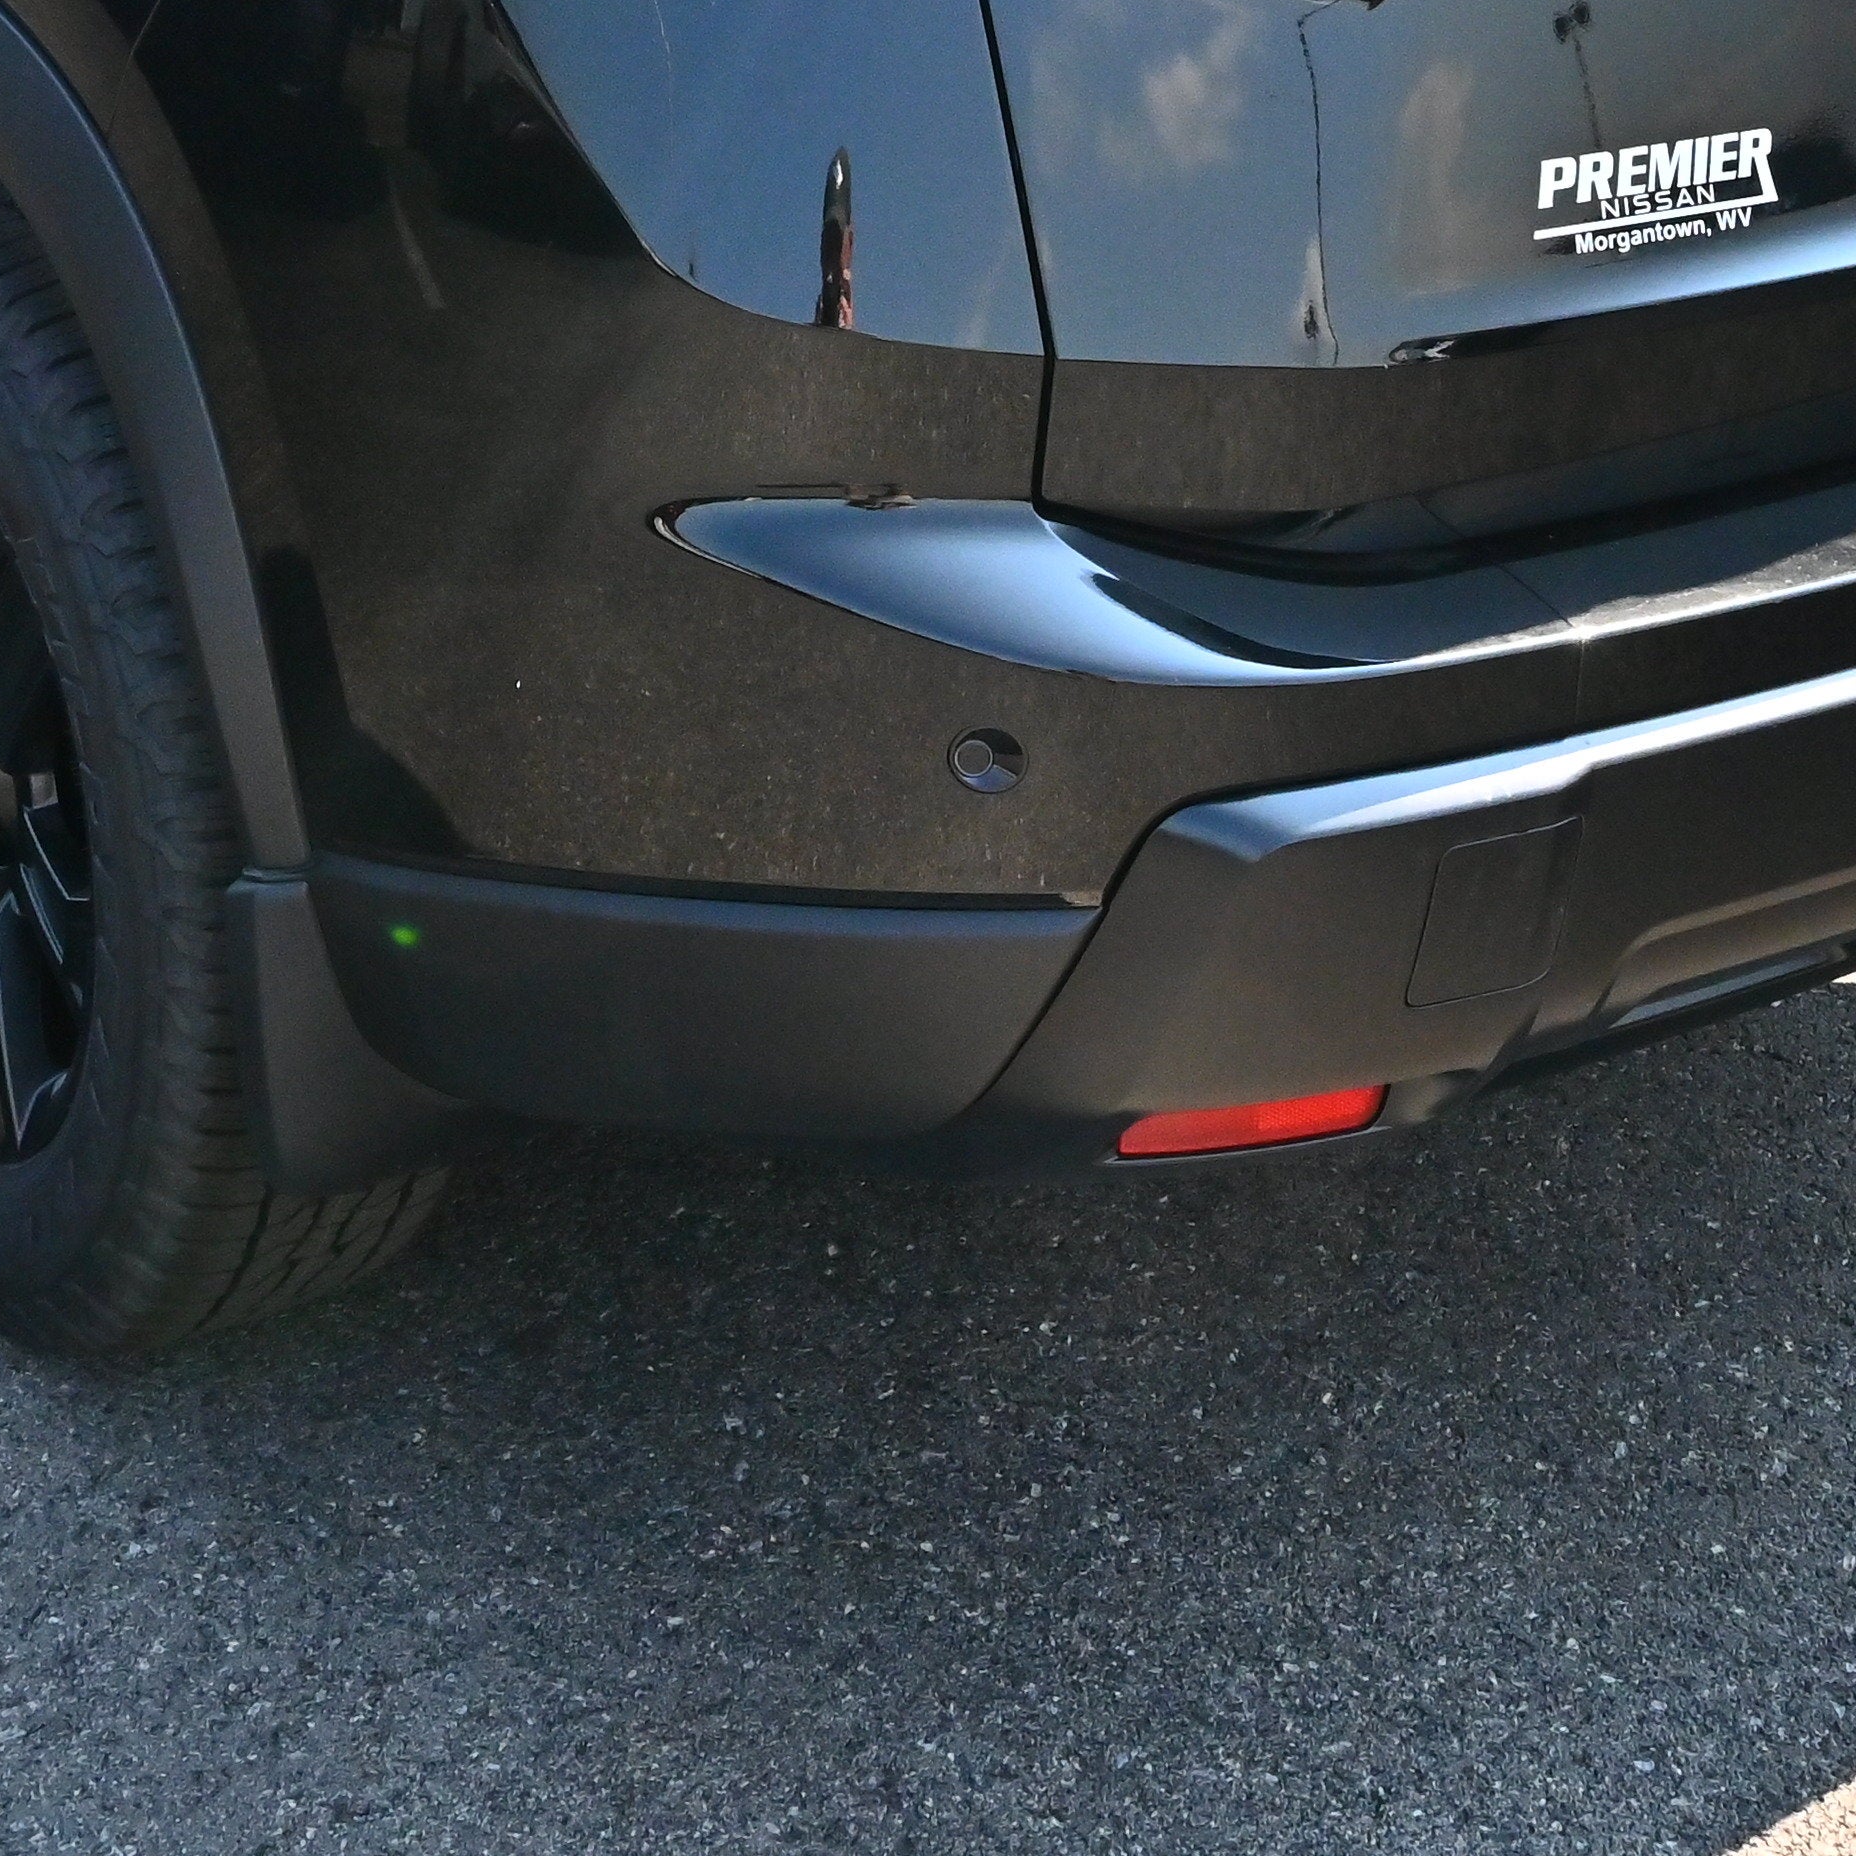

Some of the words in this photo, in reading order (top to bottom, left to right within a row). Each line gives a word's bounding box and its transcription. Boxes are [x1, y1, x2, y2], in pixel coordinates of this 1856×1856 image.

[1537, 127, 1779, 209] PREMIER
[1600, 183, 1716, 220] NISSAN
[1574, 217, 1713, 255] Morgantown,
[1715, 206, 1753, 232] WV
